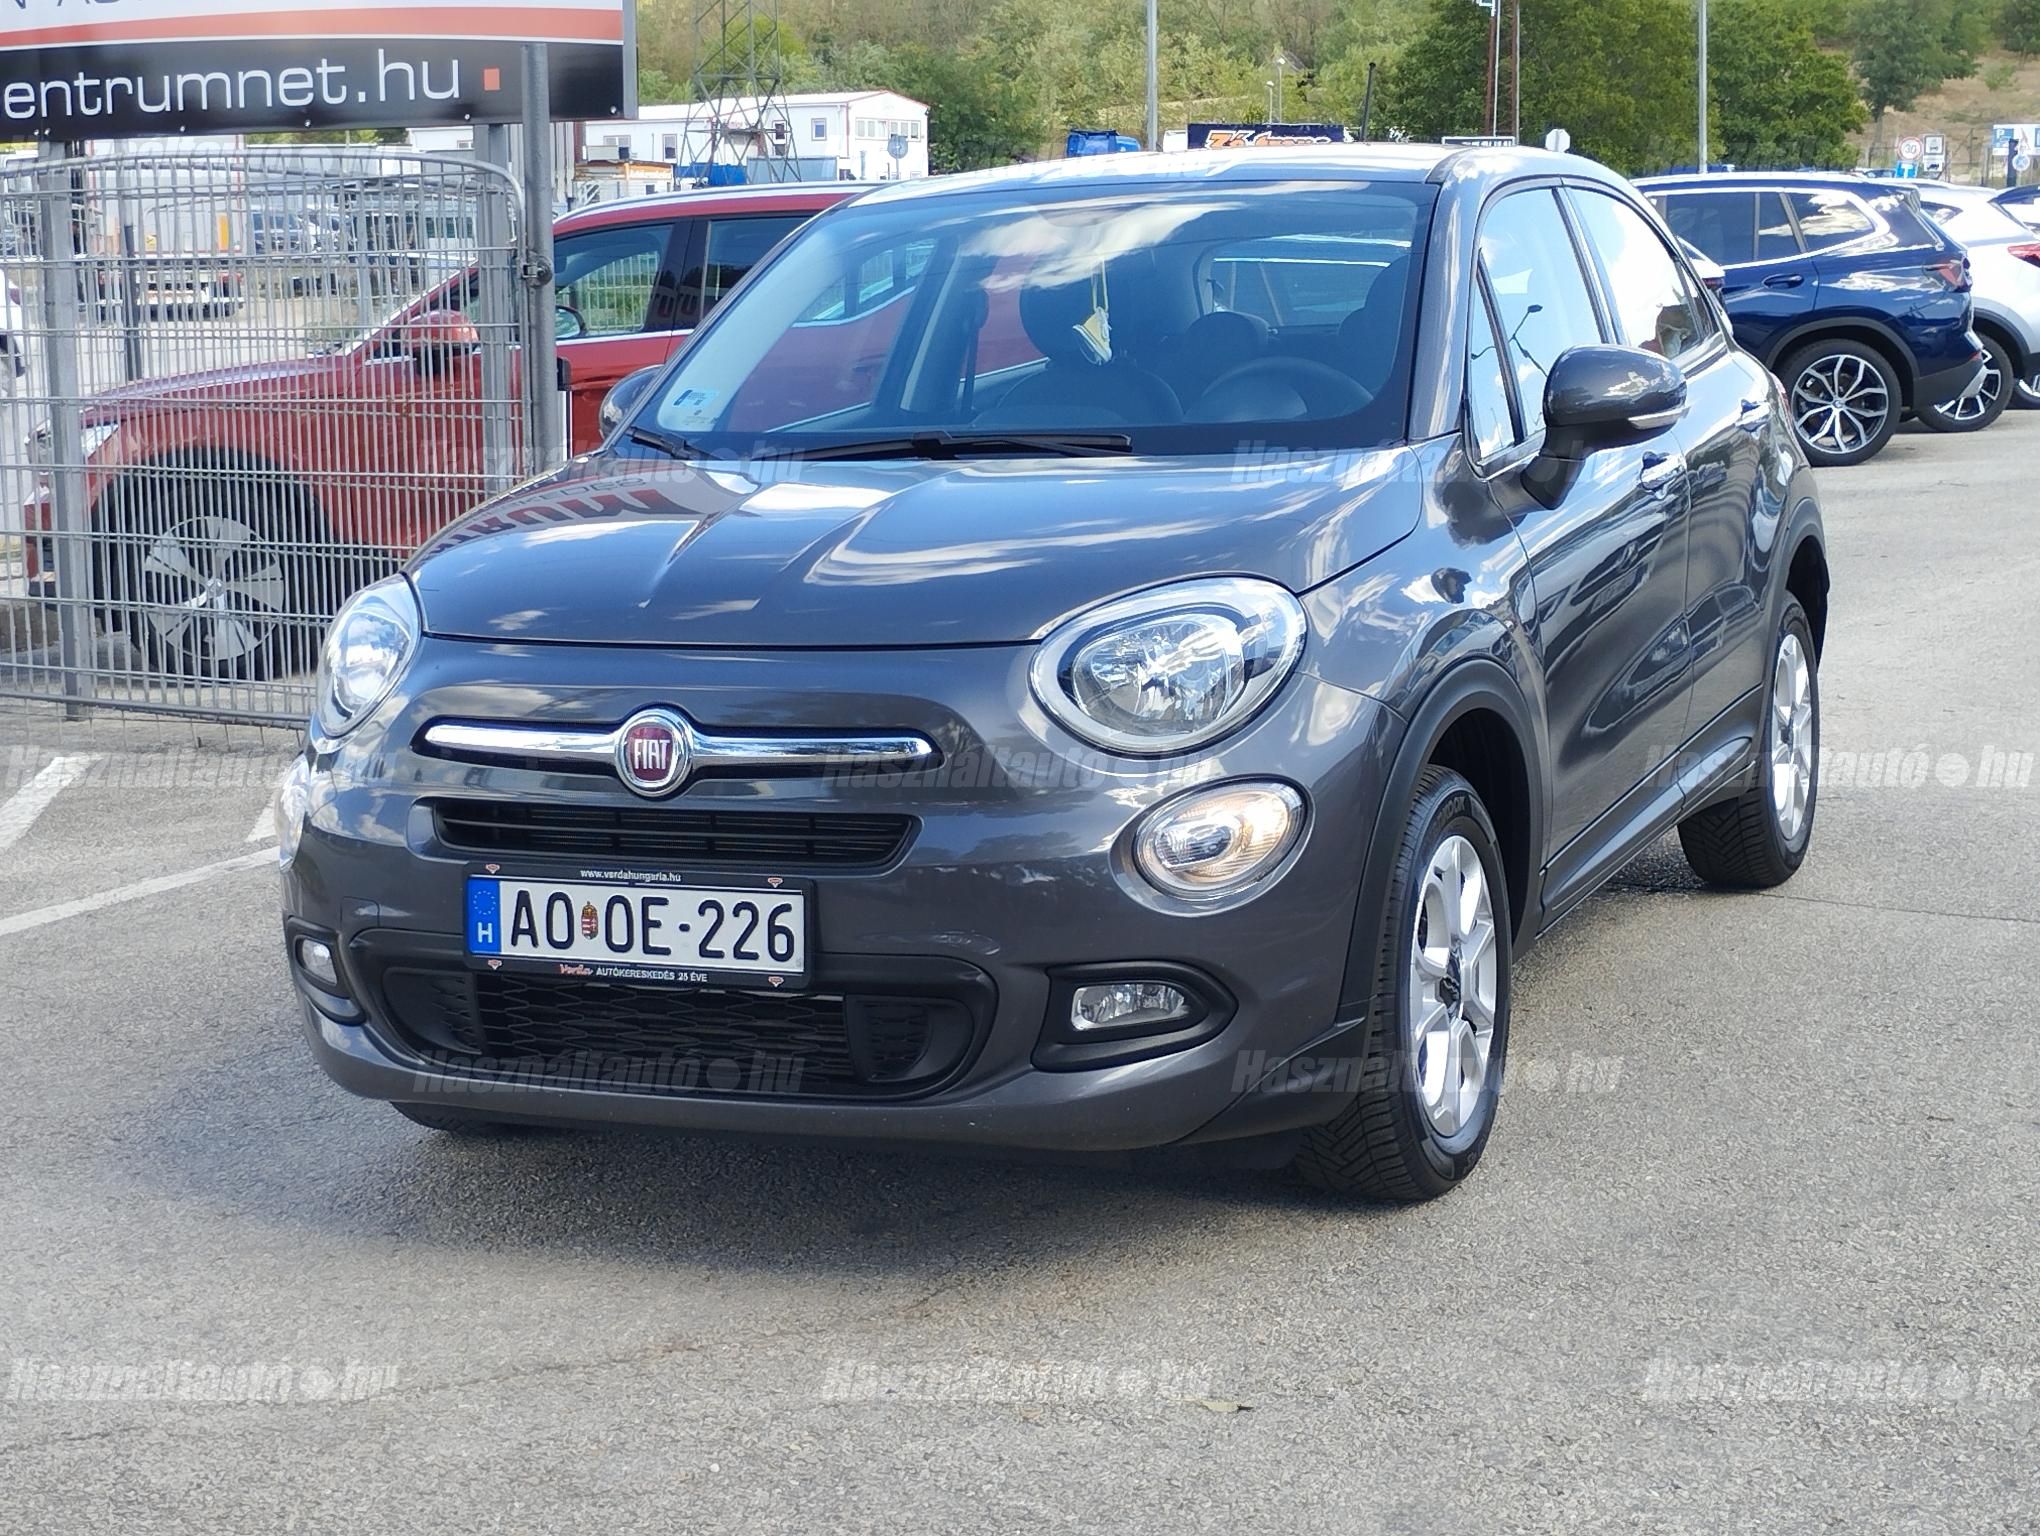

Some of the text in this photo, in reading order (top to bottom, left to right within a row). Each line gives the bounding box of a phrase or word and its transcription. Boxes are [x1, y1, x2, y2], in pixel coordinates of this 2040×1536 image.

[4, 48, 460, 119] entrumnet.hu
[1904, 143, 1917, 154] 30
[633, 738, 671, 770] FIAT
[477, 921, 493, 944] H
[690, 971, 708, 983] ÉVE
